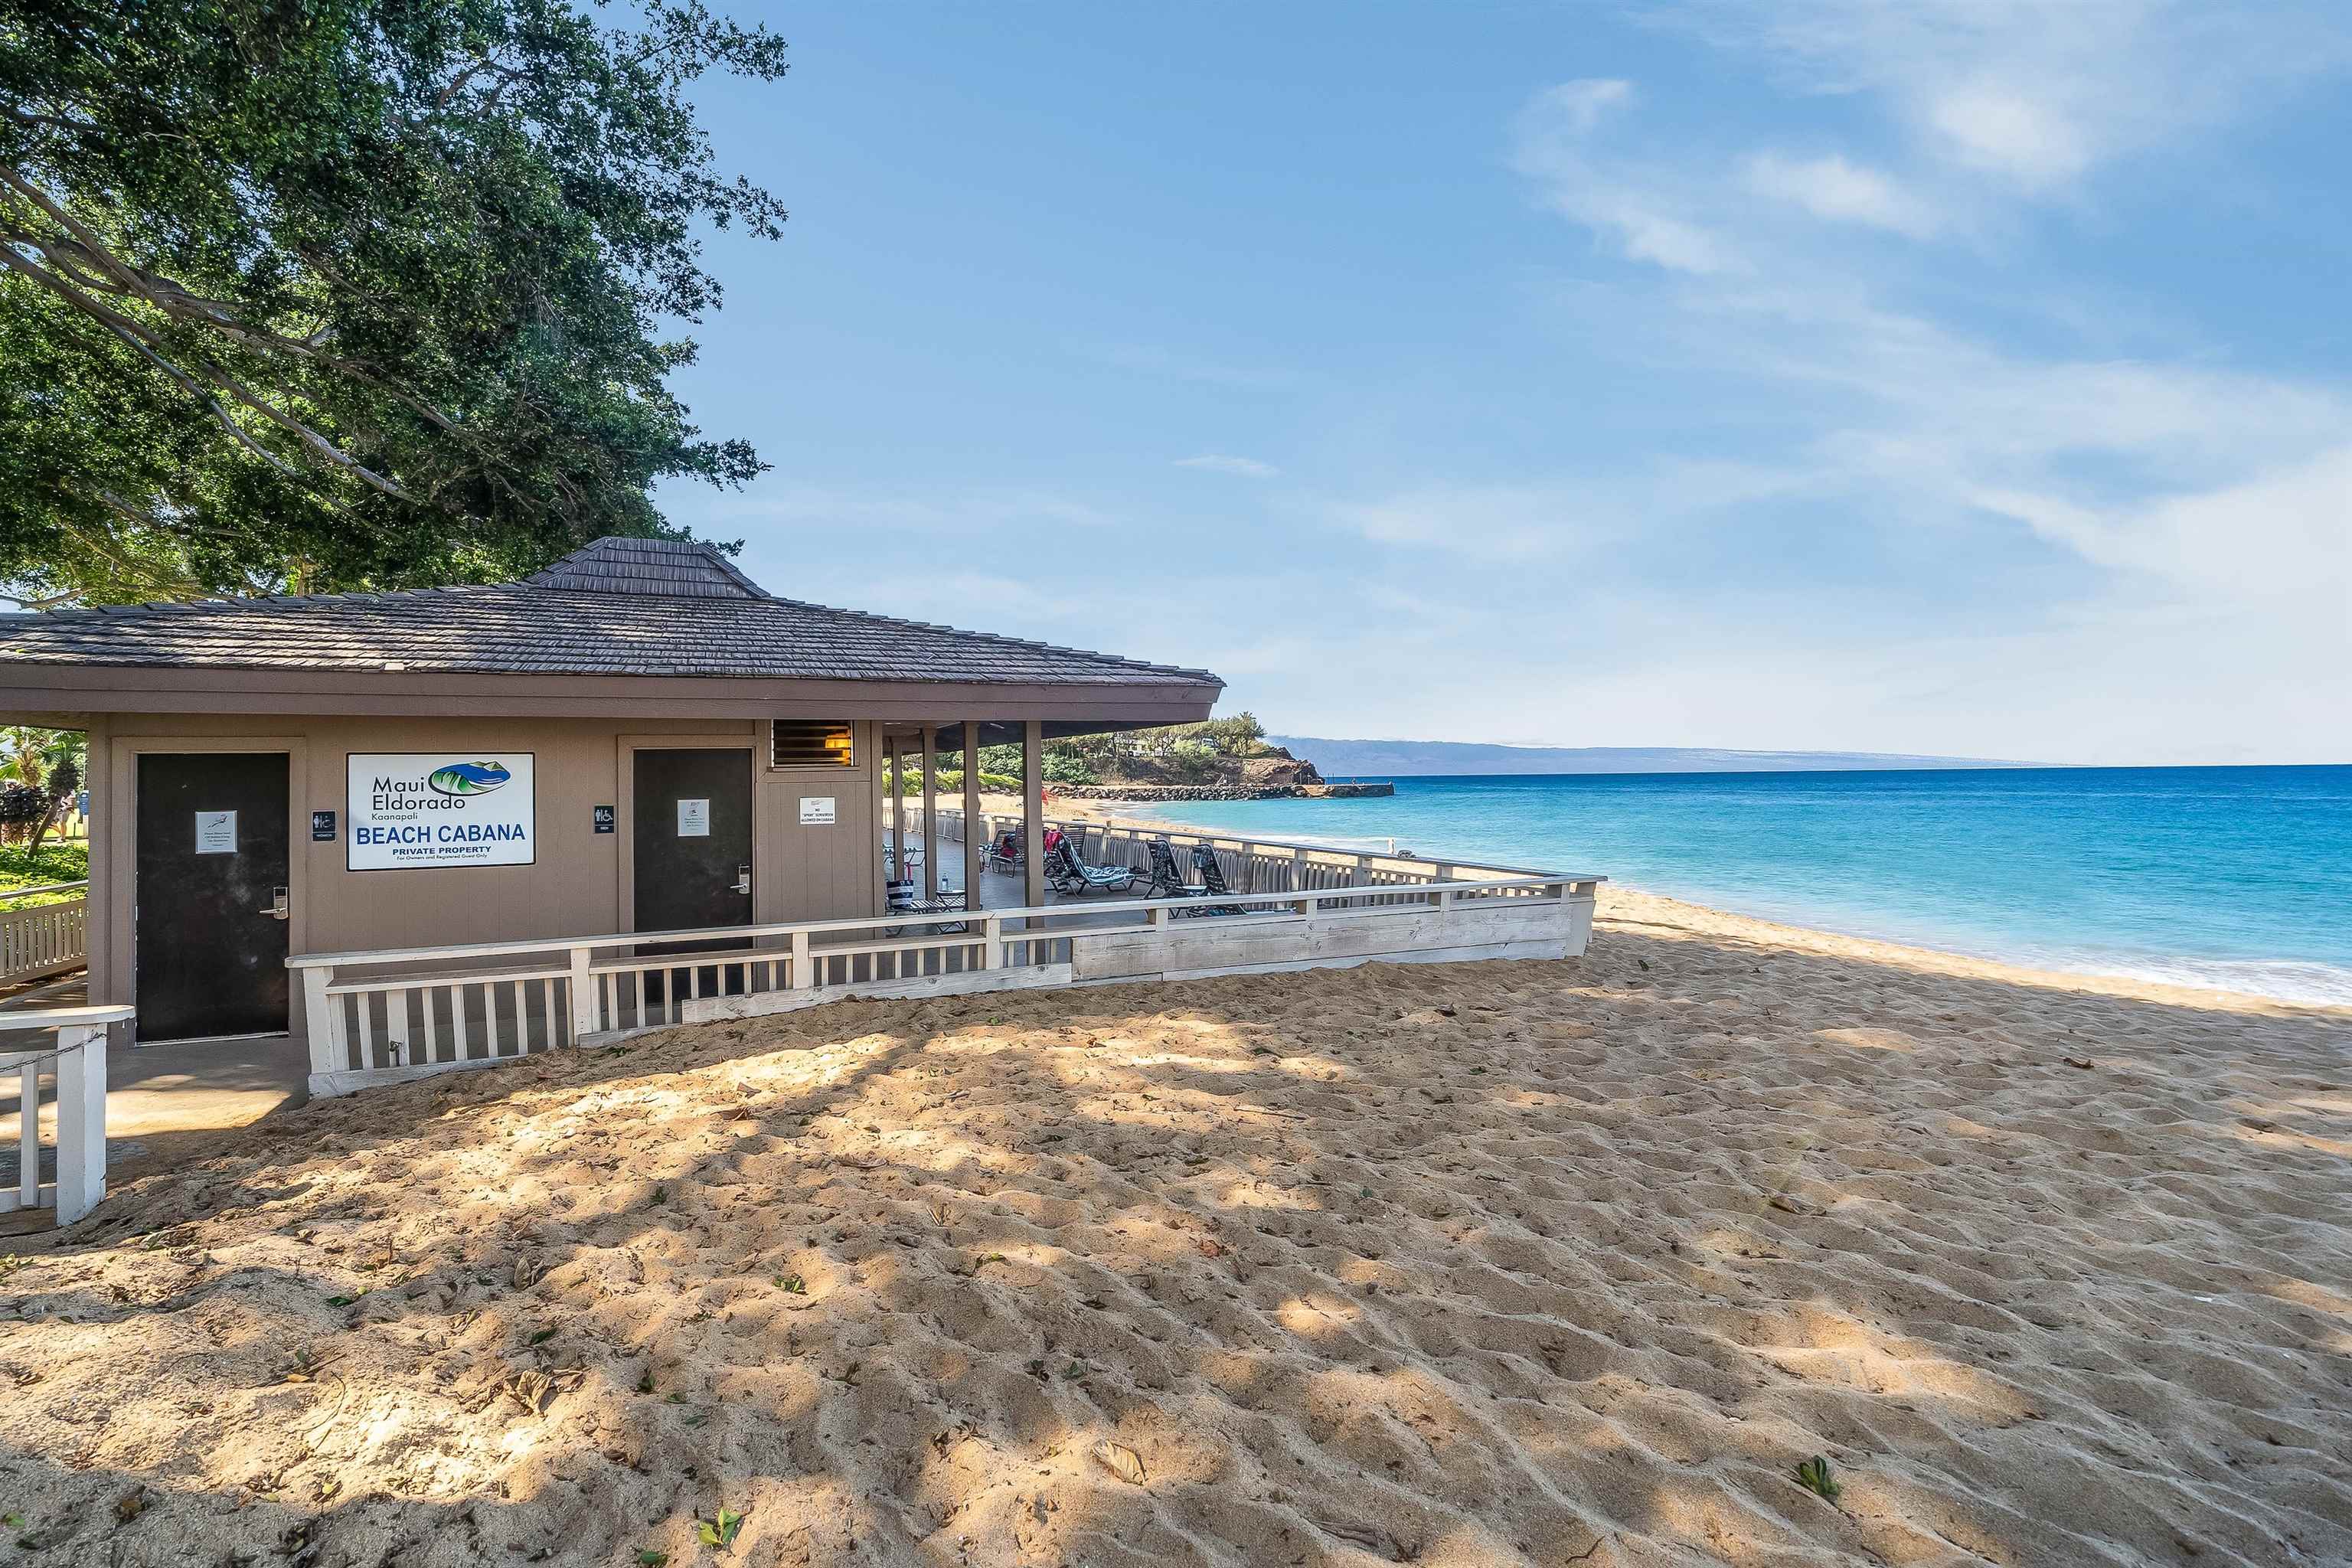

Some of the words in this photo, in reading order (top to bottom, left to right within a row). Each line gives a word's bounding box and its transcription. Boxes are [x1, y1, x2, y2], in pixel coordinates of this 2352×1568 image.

[372, 776, 424, 792] Maui
[373, 793, 466, 811] Eldorado
[371, 812, 418, 822] Kaanapali
[357, 826, 431, 844] BEACH
[438, 824, 526, 842] CABANA
